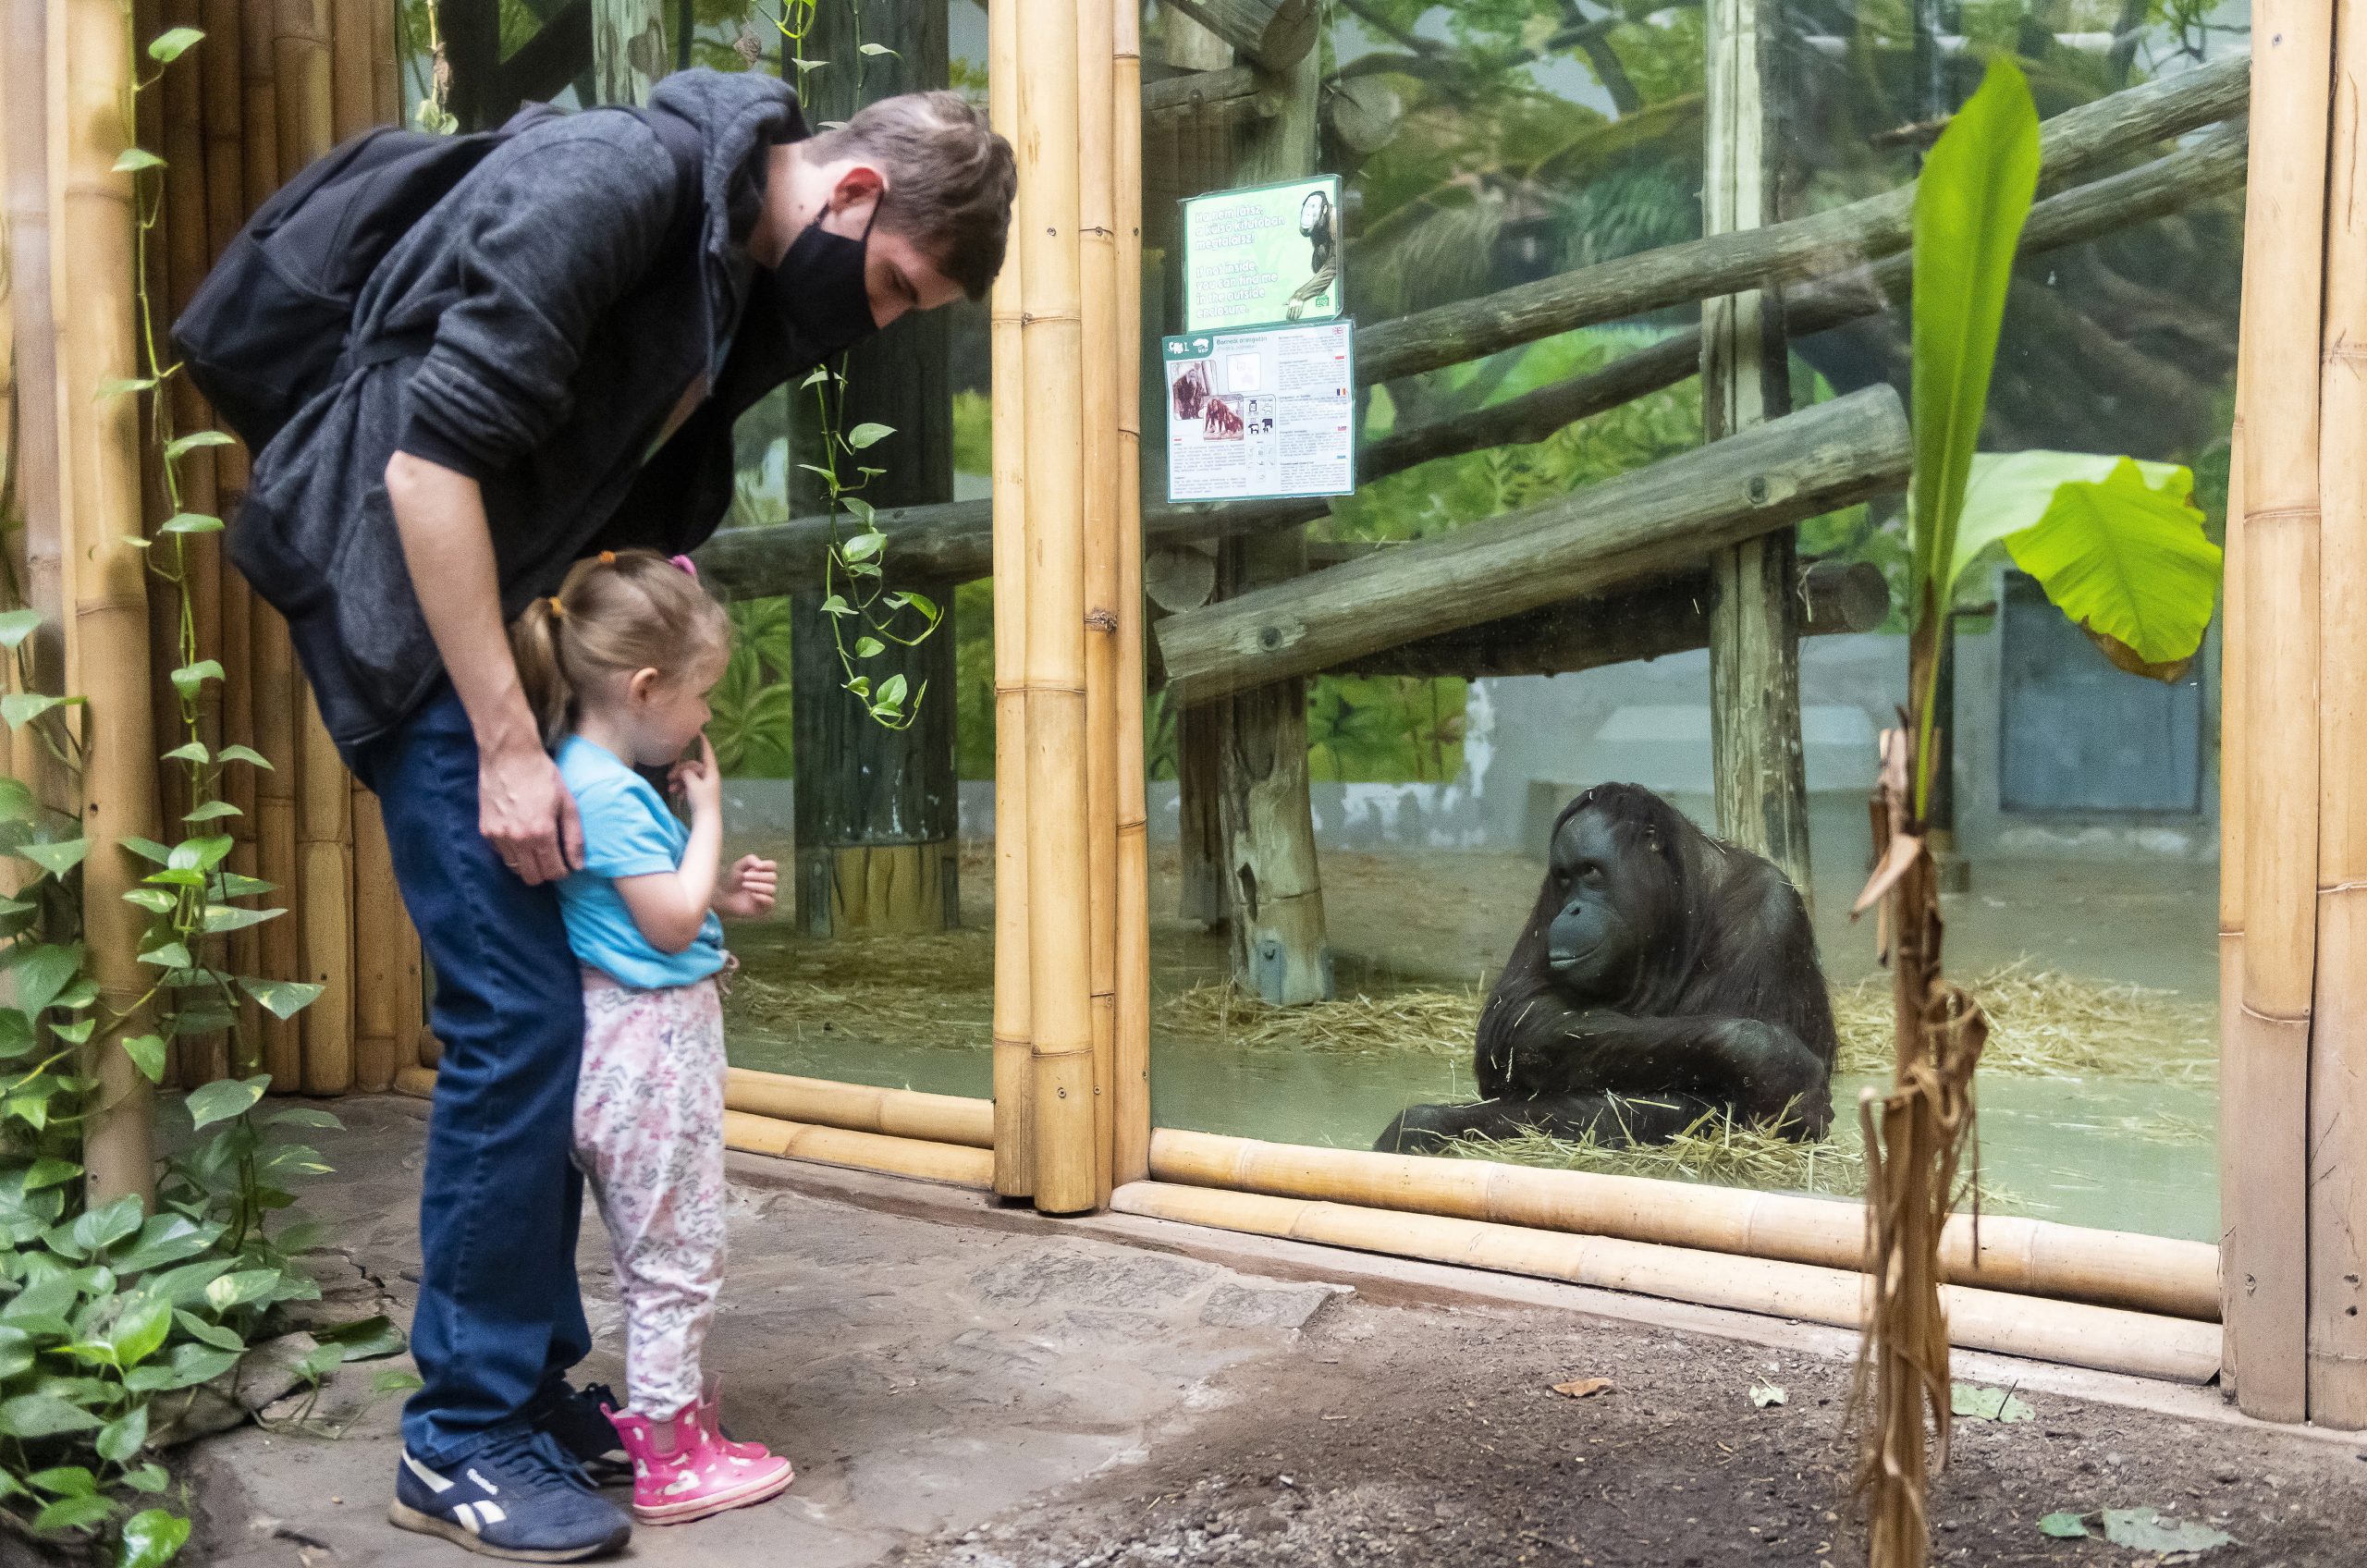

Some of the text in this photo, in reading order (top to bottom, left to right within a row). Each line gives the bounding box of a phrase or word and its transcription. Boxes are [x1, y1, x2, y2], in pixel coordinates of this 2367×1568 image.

[1212, 208, 1234, 219] nem
[1206, 264, 1222, 276] not
[1196, 272, 1278, 291] you can find me
[1196, 287, 1265, 304] in the outside
